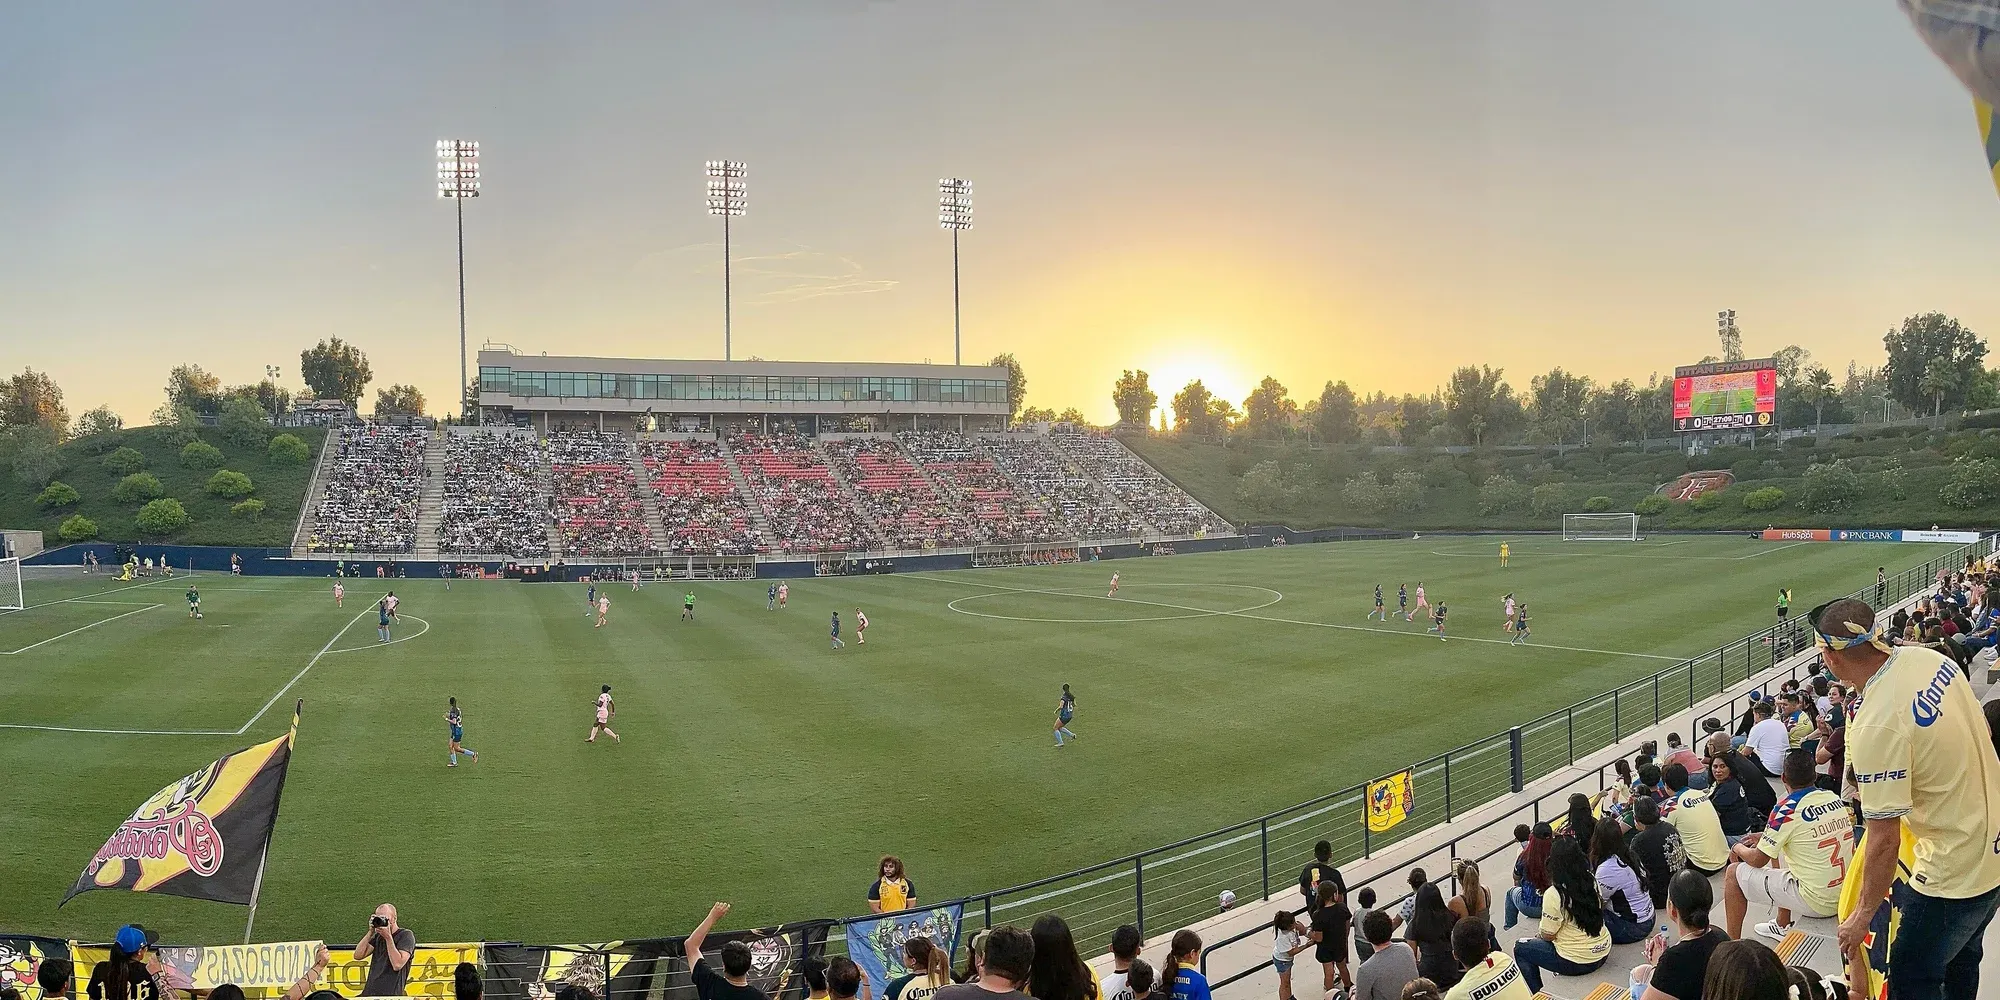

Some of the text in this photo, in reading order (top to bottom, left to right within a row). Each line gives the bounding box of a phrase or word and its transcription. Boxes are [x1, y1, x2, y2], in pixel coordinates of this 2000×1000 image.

[1677, 360, 1773, 377] TITAN STADIUM
[1694, 417, 1702, 428] 0
[1745, 414, 1753, 425] 0
[1781, 530, 1813, 540] HubSpot
[1868, 531, 1893, 540] BANK
[1801, 799, 1845, 822] Coron
[1818, 816, 1851, 836] QUIÑONE
[1472, 981, 1499, 1000] BUD
